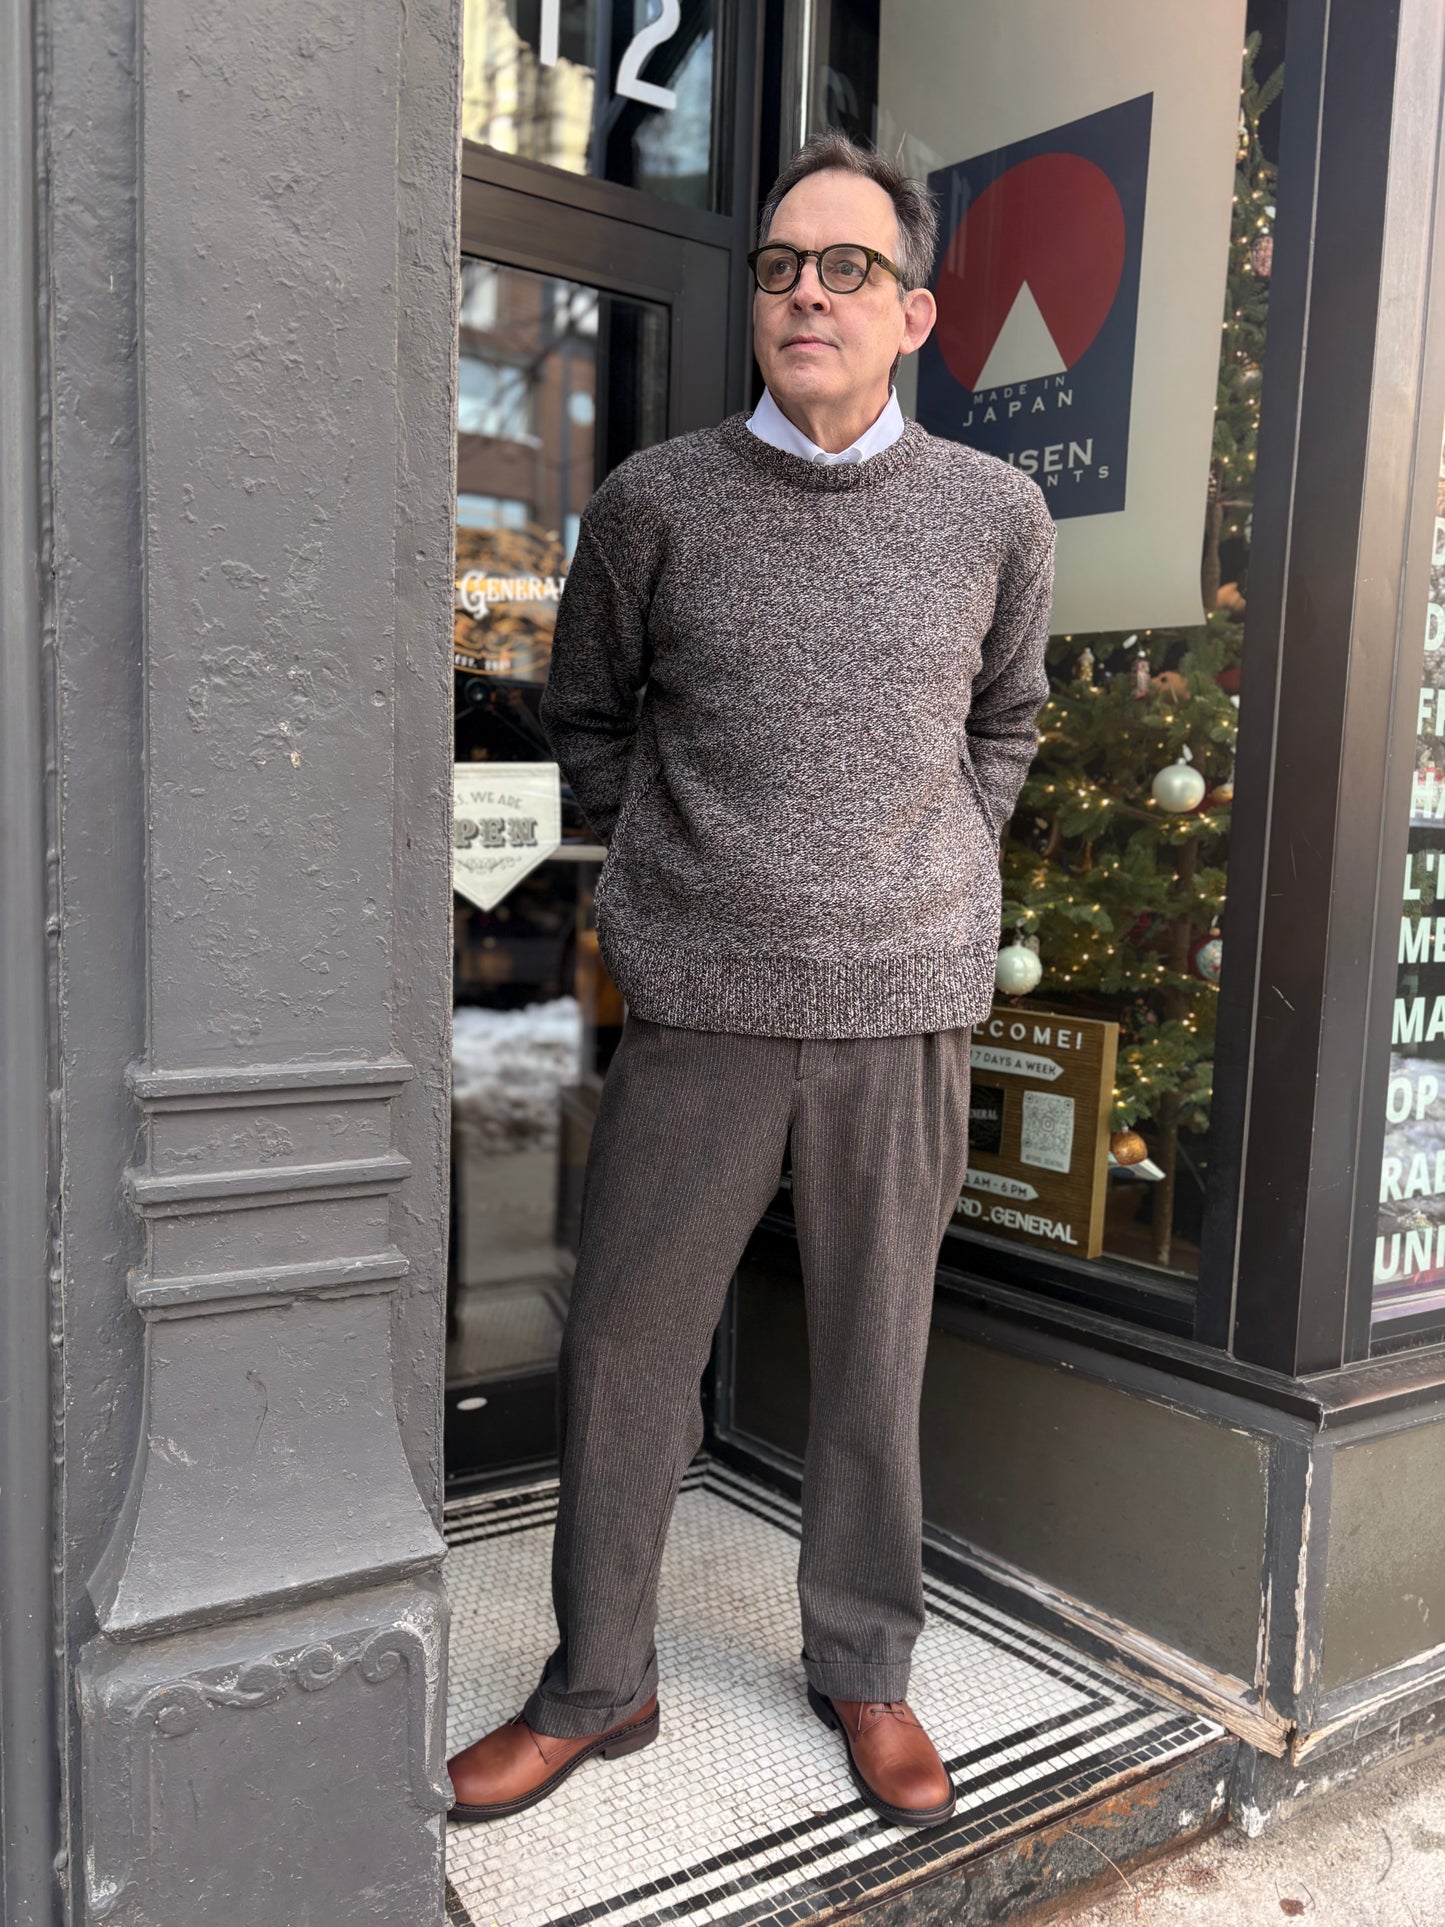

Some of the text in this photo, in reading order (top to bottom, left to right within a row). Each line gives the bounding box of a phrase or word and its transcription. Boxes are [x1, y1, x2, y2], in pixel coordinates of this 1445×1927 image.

[973, 375, 1065, 405] MADE IN
[963, 389, 1073, 427] JAPAN
[470, 791, 494, 804] WE
[497, 794, 523, 810] ARE
[1391, 995, 1445, 1045] MA
[975, 1051, 1057, 1076] 7 DAYS A WEEK
[973, 1176, 990, 1188] AM
[1001, 1182, 1007, 1193] 6
[1011, 1184, 1028, 1197] PM
